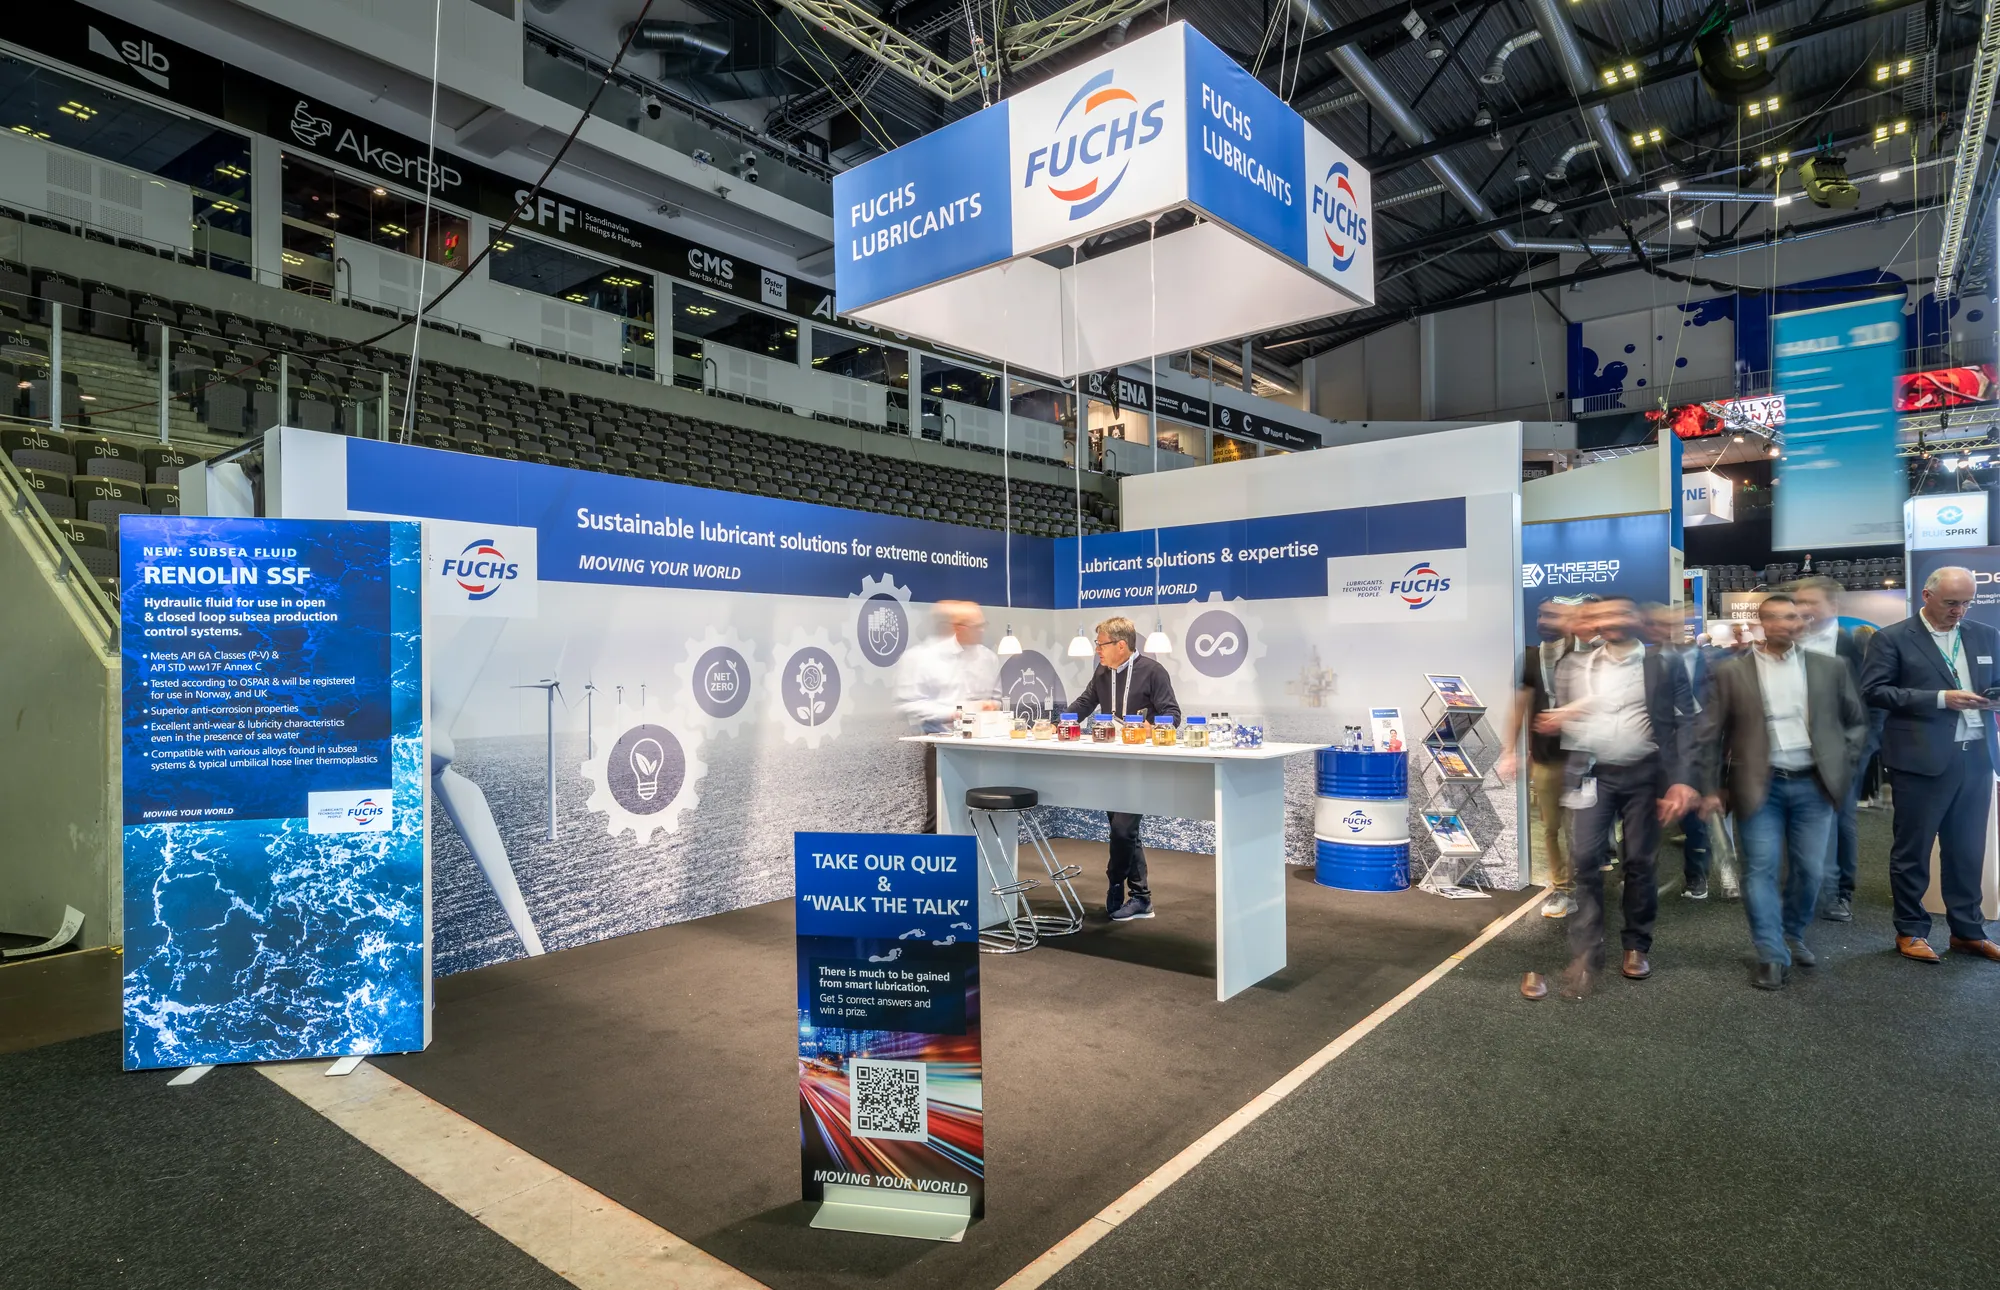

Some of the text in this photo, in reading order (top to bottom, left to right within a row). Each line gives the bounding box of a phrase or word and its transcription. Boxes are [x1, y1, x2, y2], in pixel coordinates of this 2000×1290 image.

[122, 39, 169, 73] slb
[1202, 83, 1252, 141] FUCHS
[1025, 99, 1165, 189] FUCHS
[334, 129, 463, 192] AkerBP
[1203, 125, 1293, 206] LUBRICANTS
[513, 189, 575, 233] SFF
[851, 183, 916, 228] FUCHS
[1313, 184, 1367, 245] FUCHS
[585, 212, 629, 234] Scandinavian
[852, 192, 982, 262] LUBRICANTS
[585, 223, 642, 249] Fittings & Flanges
[687, 248, 734, 281] CMS
[689, 269, 733, 290] law-tax-future
[764, 277, 784, 290] Øster
[769, 286, 782, 297] Hus
[22, 432, 50, 450] DNB
[95, 440, 119, 459] DNB
[162, 450, 184, 467] DNB
[577, 507, 988, 569] Sustainable lubricant solutions for extreme conditions
[1922, 527, 1978, 538] BLUESPARK
[143, 547, 297, 558] NEW: SUBSEA FLUID
[1078, 542, 1318, 574] Lubricant solutions & expertise
[144, 566, 311, 584] RENOLIN SSF
[442, 559, 518, 580] FUCHS
[578, 555, 741, 580] MOVING YOUR WORLD
[1547, 570, 1620, 585] ENERGY
[1079, 582, 1197, 600] MOVING YOUR WORLD
[1390, 578, 1451, 594] FUCHS
[144, 597, 202, 611] Hydraulic
[205, 597, 233, 607] fluid
[236, 598, 254, 607] for
[281, 598, 292, 607] in
[295, 600, 325, 610] open
[144, 611, 338, 625] & closed loop subsea production
[144, 627, 242, 639] control systems.
[150, 650, 279, 660] Meets API 6A Classes (P-V) &
[150, 663, 166, 672] API
[168, 662, 186, 671] STD
[224, 662, 252, 671] Annex
[255, 662, 262, 671] C
[151, 676, 355, 689] Tested according to OSPAR & will be registered
[713, 672, 731, 682] NET
[711, 681, 734, 692] ZERO
[151, 691, 164, 699] for
[195, 690, 232, 701] Norway,
[234, 689, 251, 698] and
[254, 689, 268, 698] UK
[151, 704, 299, 717] Superior anti-corrosion properties
[151, 718, 345, 731] Excellent anti-wear & lubricity characteristics
[175, 733, 184, 741] in
[186, 733, 201, 741] the
[203, 733, 243, 743] presence
[245, 731, 255, 740] of
[257, 732, 272, 740] sea
[274, 731, 300, 740] water
[151, 744, 358, 760] Compatible with various alloys found in subsea
[151, 754, 378, 771] systems & typical umbilical hose liner thermoplastics
[143, 807, 234, 818] MOVING YOUR WORLD
[347, 807, 383, 816] FUCHS
[1342, 817, 1372, 826] FUCHS
[812, 853, 957, 874] TAKE OUR QUIZ
[877, 876, 892, 892] &
[871, 897, 907, 914] THE
[818, 967, 950, 983] There is much to be gained
[819, 978, 929, 993] from smart lubrication.
[819, 994, 931, 1008] Get 5 correct answers and
[820, 1007, 835, 1015] win
[846, 1007, 867, 1018] prize.
[813, 1170, 968, 1195] MOVING YOUR WORLD
